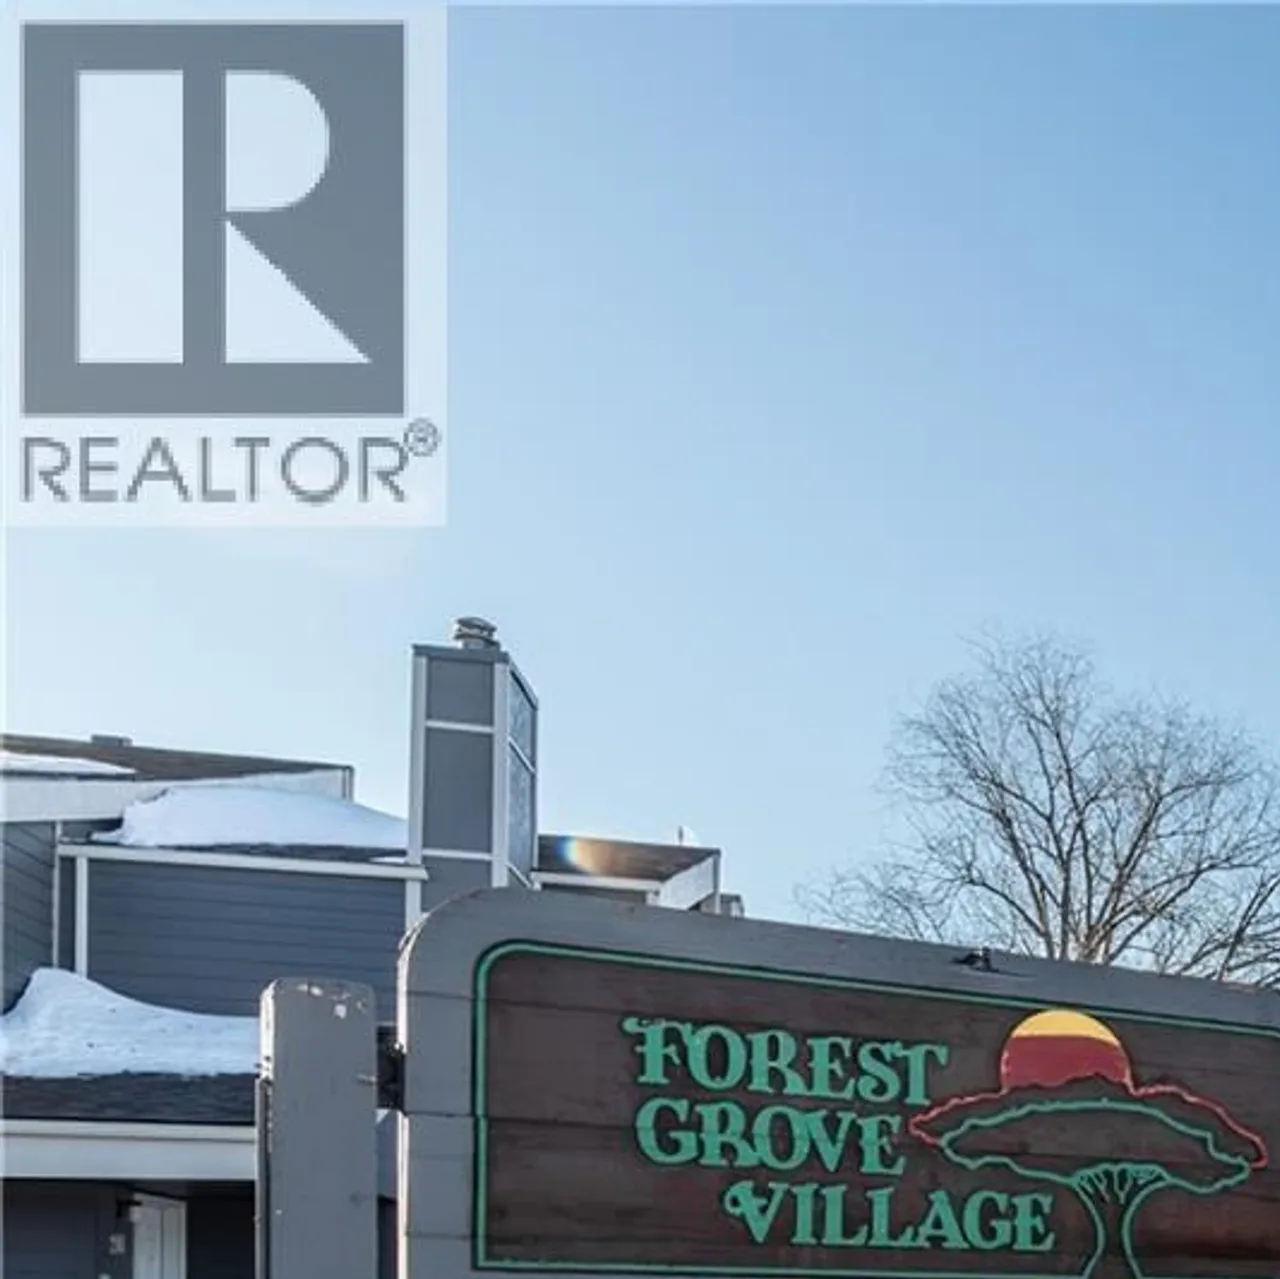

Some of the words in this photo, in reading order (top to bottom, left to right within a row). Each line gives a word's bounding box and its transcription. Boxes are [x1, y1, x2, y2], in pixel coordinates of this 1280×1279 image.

[622, 1016, 949, 1106] FOREST
[635, 1098, 904, 1175] GROVE
[723, 1179, 1056, 1251] VILLAGE
